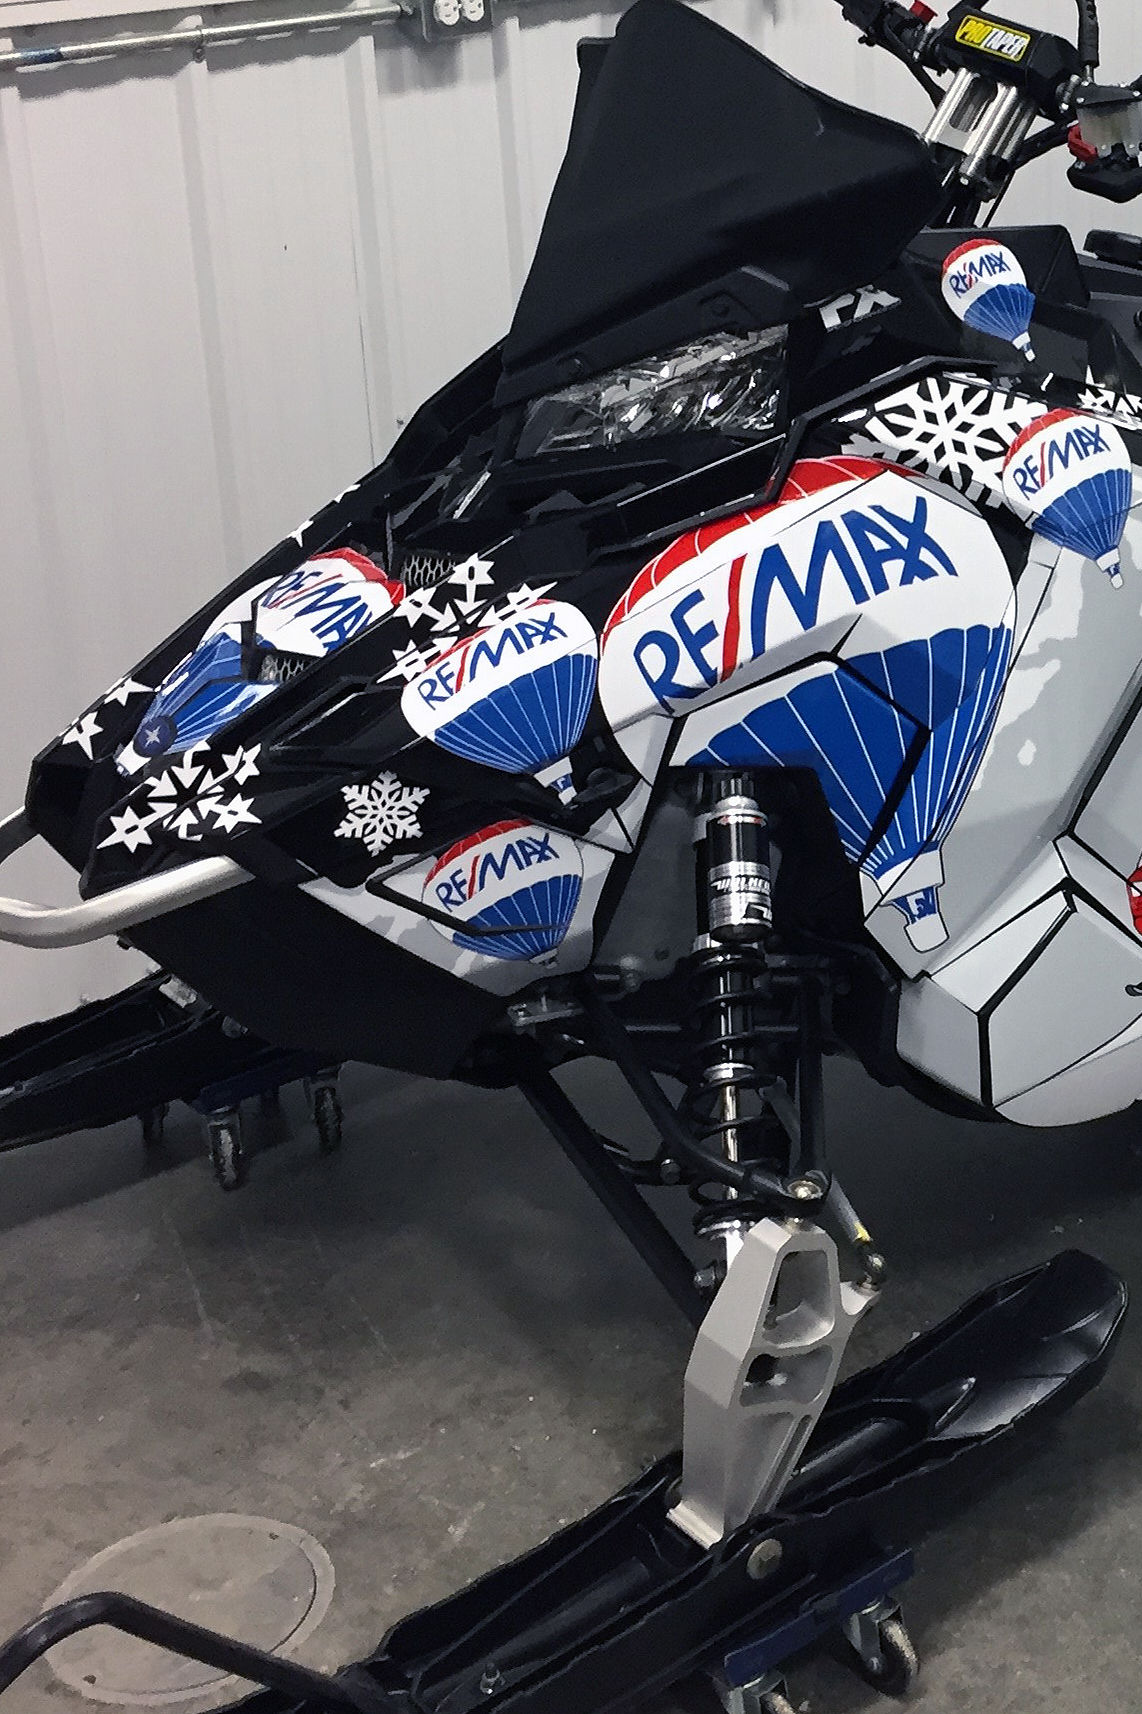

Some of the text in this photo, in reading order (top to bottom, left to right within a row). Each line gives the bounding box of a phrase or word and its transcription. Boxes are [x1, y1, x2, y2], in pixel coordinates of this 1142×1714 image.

[949, 251, 1011, 299] RE/MAX
[1013, 424, 1112, 501] RE/MAX
[633, 495, 959, 715] RE/MAX
[417, 611, 569, 711] RE/MAX
[435, 832, 560, 913] RE/MAX
